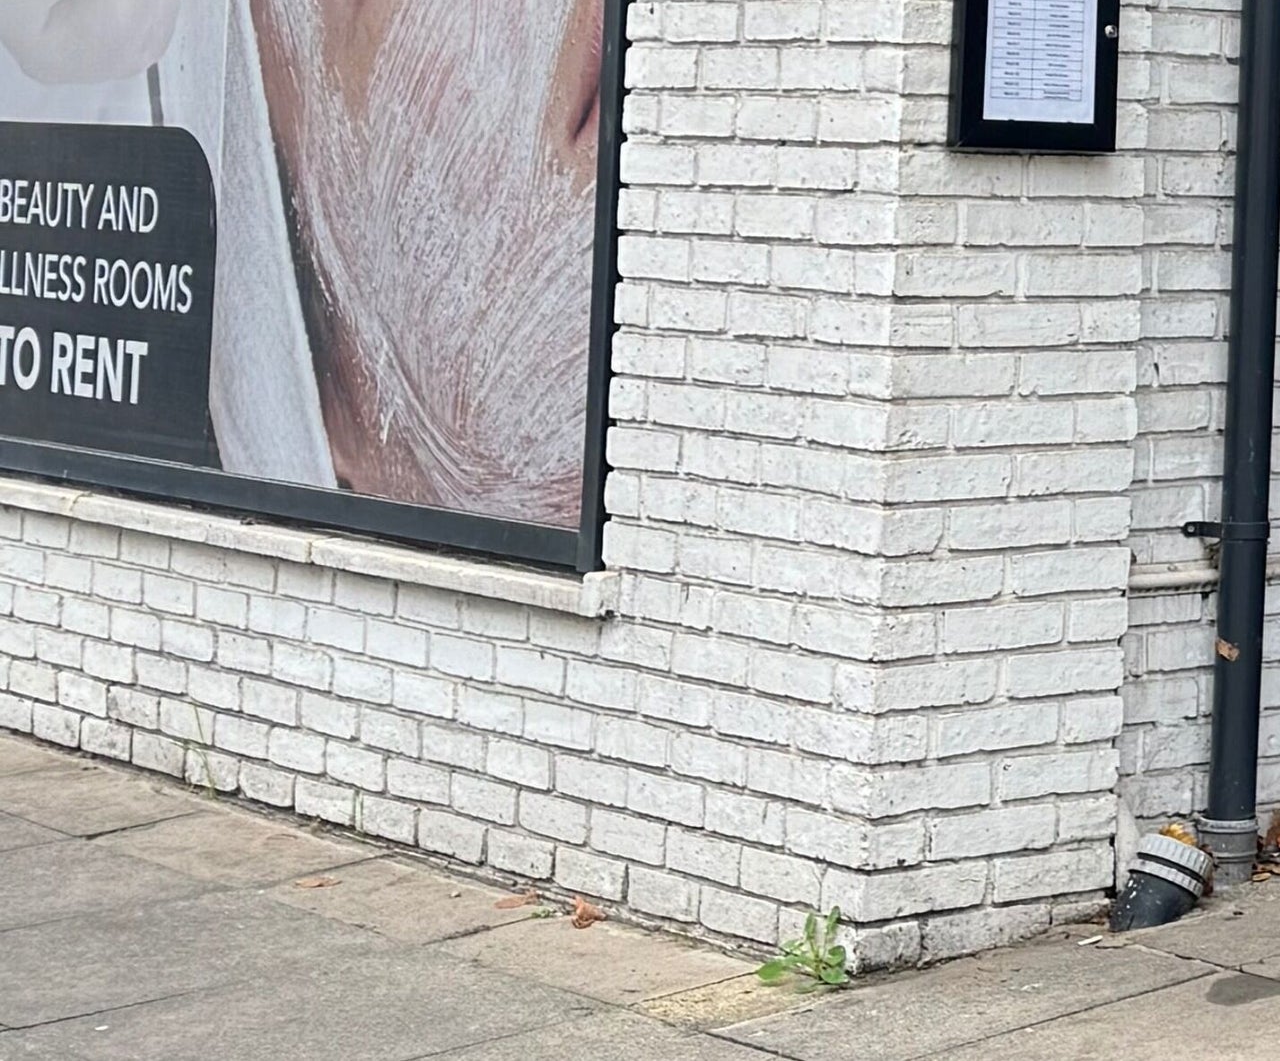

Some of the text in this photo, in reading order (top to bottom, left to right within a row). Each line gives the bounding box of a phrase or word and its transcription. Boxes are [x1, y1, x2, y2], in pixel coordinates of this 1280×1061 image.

[0, 179, 158, 233] BEAUTY AND
[93, 258, 193, 314] ROOMS
[0, 325, 148, 404] TO RENT
